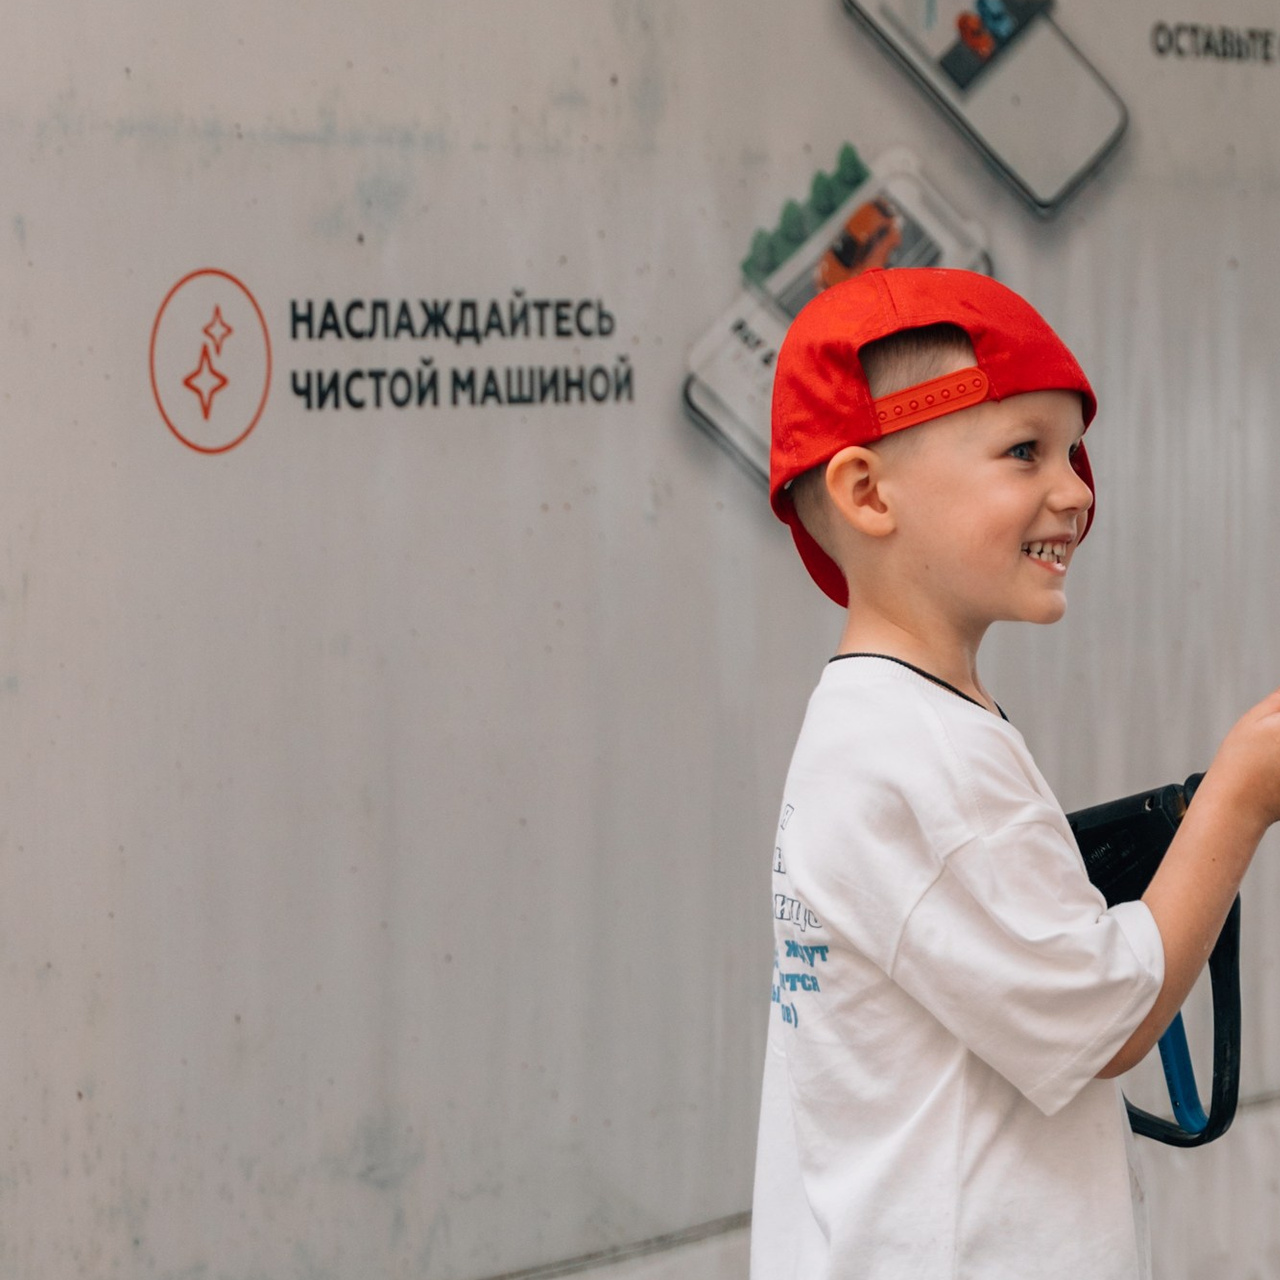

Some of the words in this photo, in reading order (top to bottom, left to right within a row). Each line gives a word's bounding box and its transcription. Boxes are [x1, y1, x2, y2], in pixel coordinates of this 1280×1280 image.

[1152, 21, 1275, 64] ОСТАВЬТЕ
[289, 288, 616, 346] НАСЛАЖДАЙТЕСЬ
[290, 356, 440, 411] ЧИСТОЙ
[450, 354, 634, 408] МАШИНОЙ
